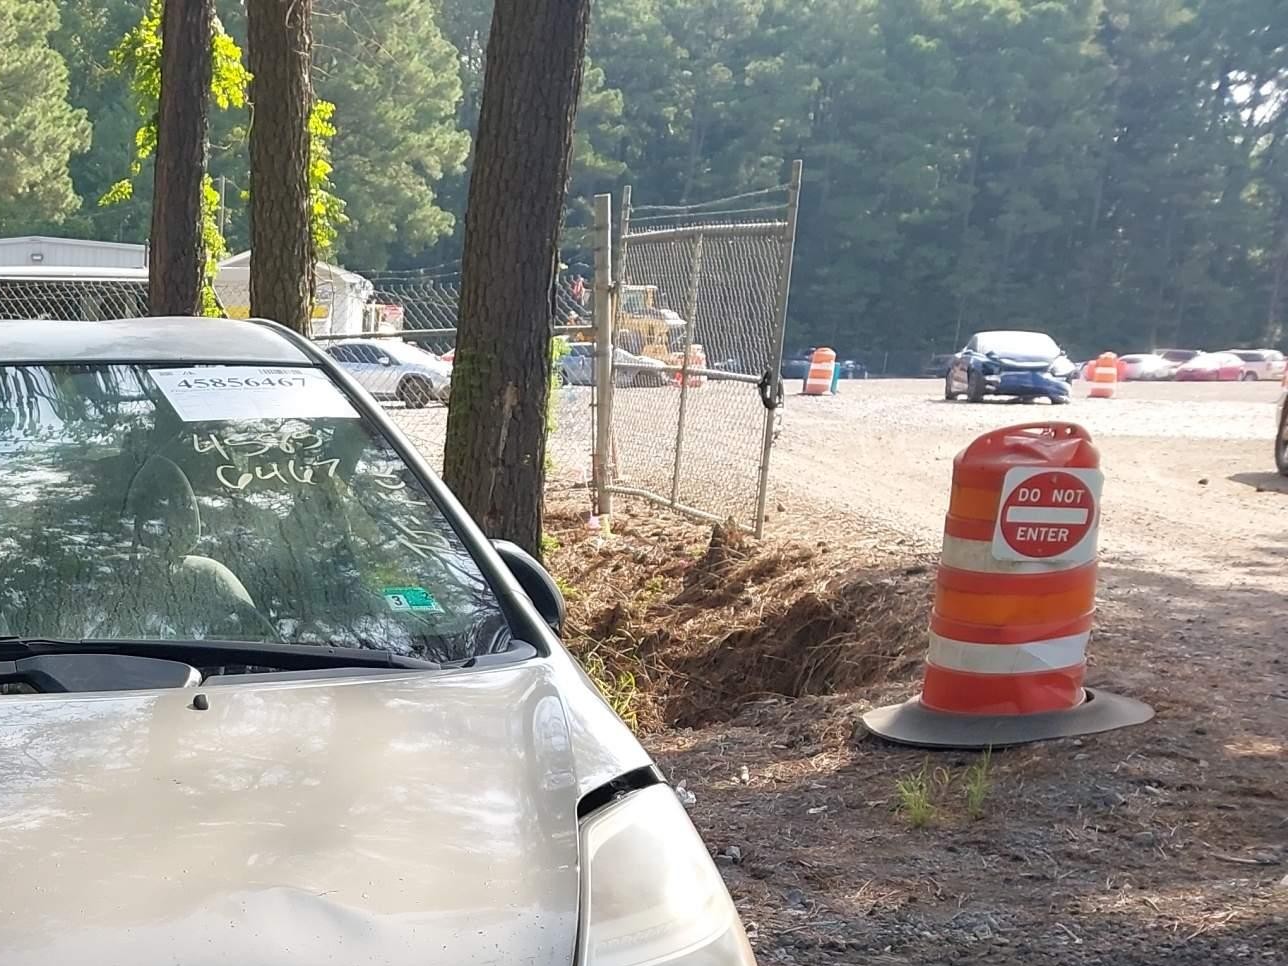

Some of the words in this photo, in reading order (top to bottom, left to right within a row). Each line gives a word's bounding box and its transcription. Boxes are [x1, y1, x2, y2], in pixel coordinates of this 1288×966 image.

[177, 377, 306, 389] 45856467
[215, 457, 341, 490] 6467
[1018, 488, 1041, 502] DO
[1052, 489, 1086, 504] NOT
[1015, 526, 1070, 543] ENTER
[391, 595, 403, 606] 3
